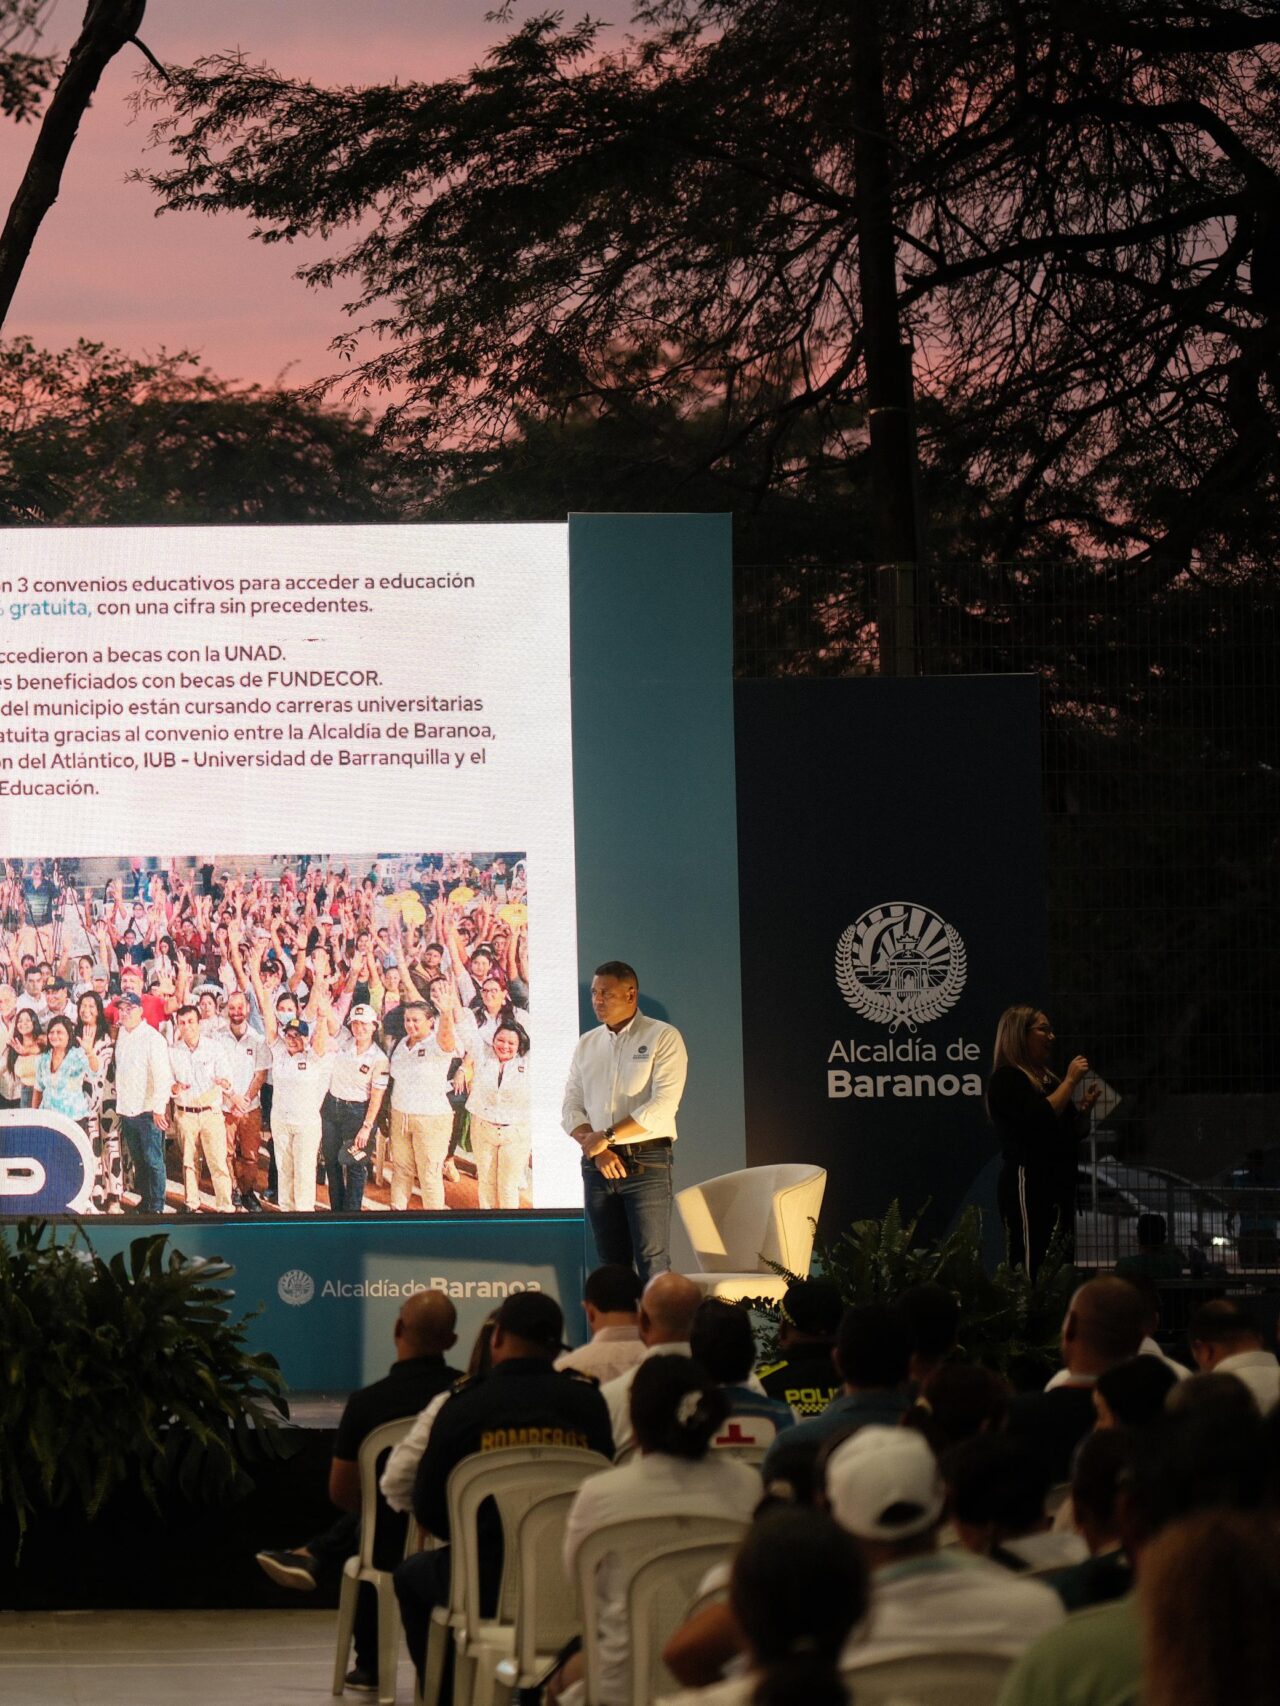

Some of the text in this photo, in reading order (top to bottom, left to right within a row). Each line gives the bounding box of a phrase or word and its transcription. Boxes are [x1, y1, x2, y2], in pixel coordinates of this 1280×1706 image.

[18, 577, 28, 592] 3
[33, 576, 127, 592] convenios
[132, 575, 234, 592] educativos
[240, 578, 280, 594] para
[286, 574, 359, 590] acceder
[365, 577, 374, 589] a
[379, 573, 474, 589] educación
[10, 599, 91, 620] gratuita,
[97, 603, 130, 615] con
[136, 603, 168, 614] una
[174, 598, 215, 614] cifra
[220, 598, 245, 614] sin
[251, 597, 372, 617] precedentes.
[93, 651, 102, 663] a
[108, 647, 162, 662] becas
[167, 650, 200, 662] con
[206, 646, 220, 661] la
[225, 645, 285, 661] UNAD.
[17, 673, 137, 690] beneficiados
[142, 677, 175, 688] con
[180, 672, 235, 688] becas
[240, 672, 263, 687] de
[268, 670, 382, 687] FUNDECOR.
[1, 701, 28, 716] del
[34, 699, 123, 719] municipio
[129, 699, 180, 714] están
[185, 698, 271, 714] cursando
[276, 701, 353, 713] carreras
[358, 696, 483, 712] universitarias
[54, 726, 120, 747] gracias
[125, 726, 139, 741] al
[145, 725, 229, 741] convenio
[234, 725, 283, 740] entre
[289, 724, 303, 739] la
[308, 723, 381, 739] Alcaldía
[386, 723, 409, 738] de
[415, 723, 495, 740] Baranoa,
[18, 753, 46, 769] del
[50, 752, 138, 771] Atlántico,
[144, 752, 176, 767] IUB
[194, 750, 305, 767] Universidad
[310, 750, 333, 766] de
[339, 749, 449, 768] Barranquilla
[455, 753, 465, 768] y
[471, 748, 485, 764] el
[827, 1038, 981, 1063] Alcaldía de
[827, 1069, 983, 1098] Baranoa
[321, 1279, 399, 1298] Alcaldía
